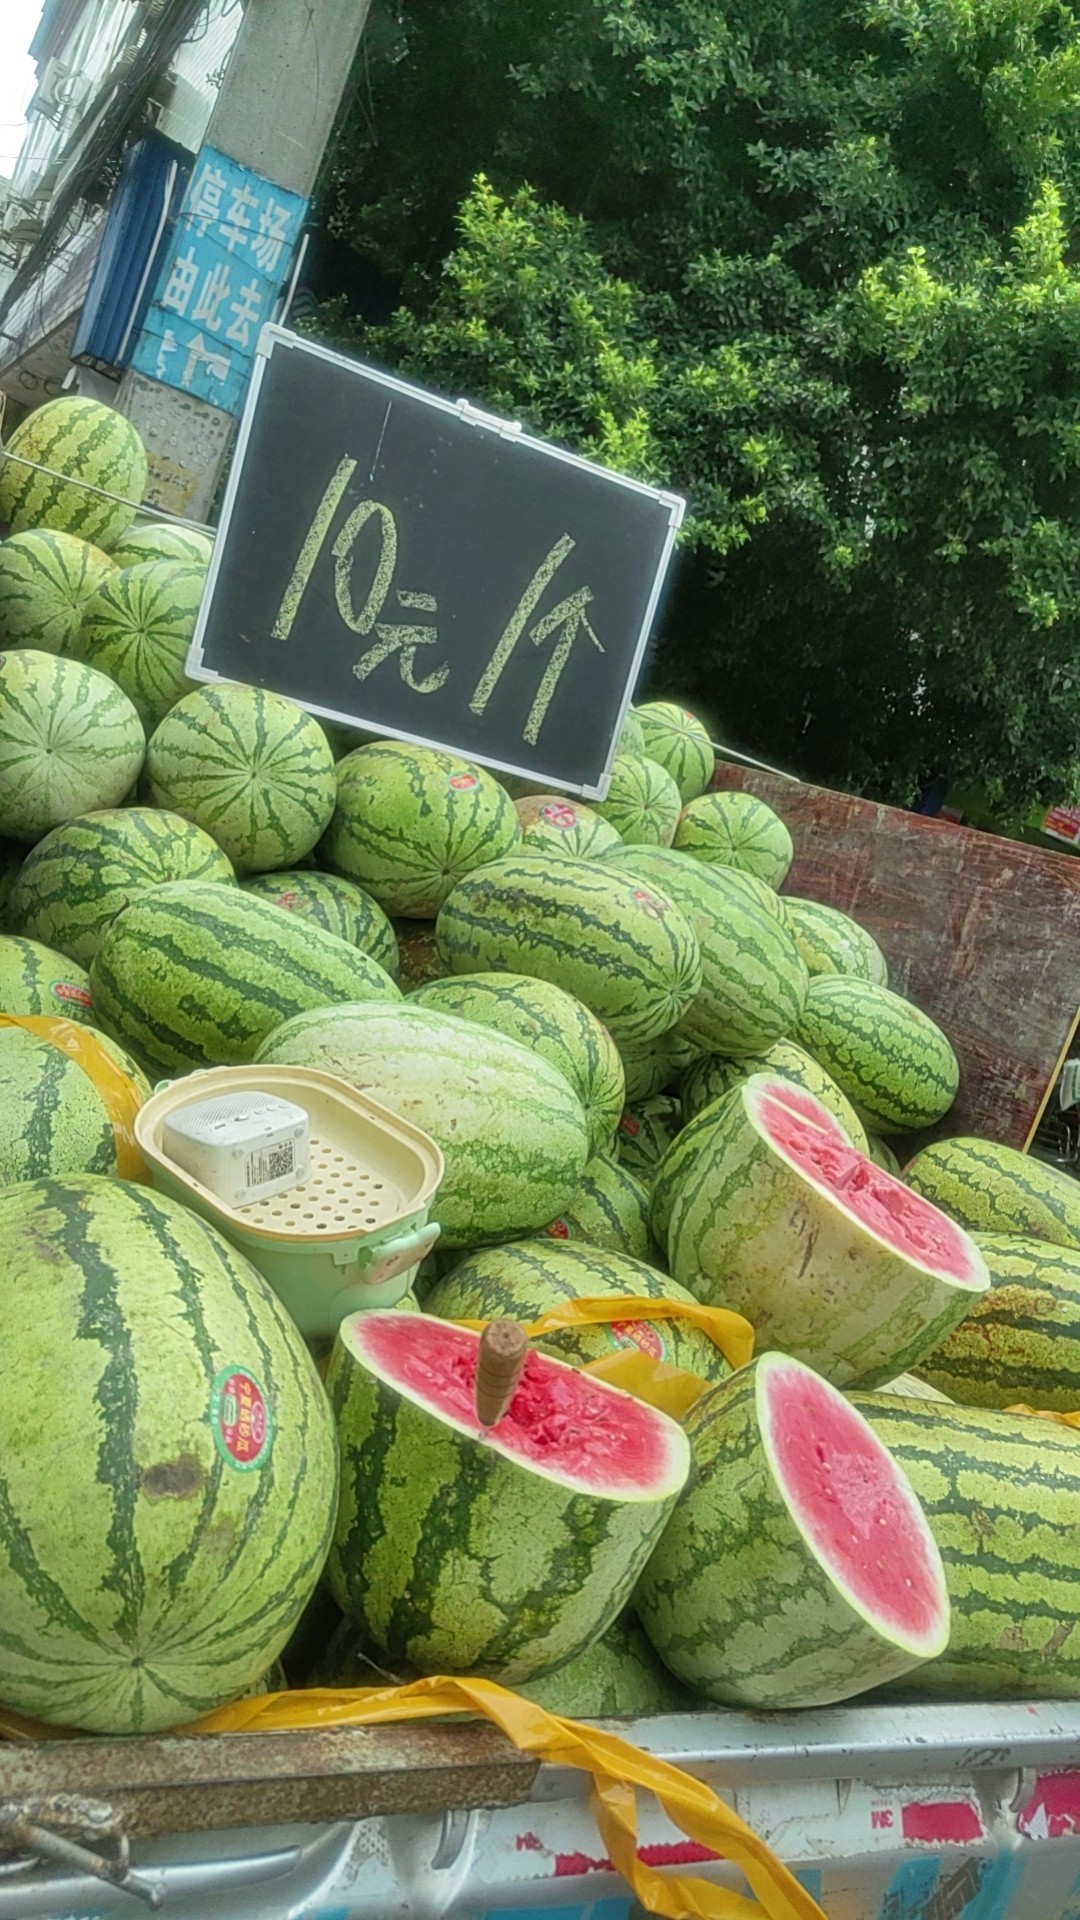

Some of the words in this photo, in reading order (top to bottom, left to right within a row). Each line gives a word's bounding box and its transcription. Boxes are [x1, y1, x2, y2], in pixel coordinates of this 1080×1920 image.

[185, 163, 291, 273] 停车场
[163, 246, 262, 348] 由此去
[871, 1810, 894, 1829] 3M
